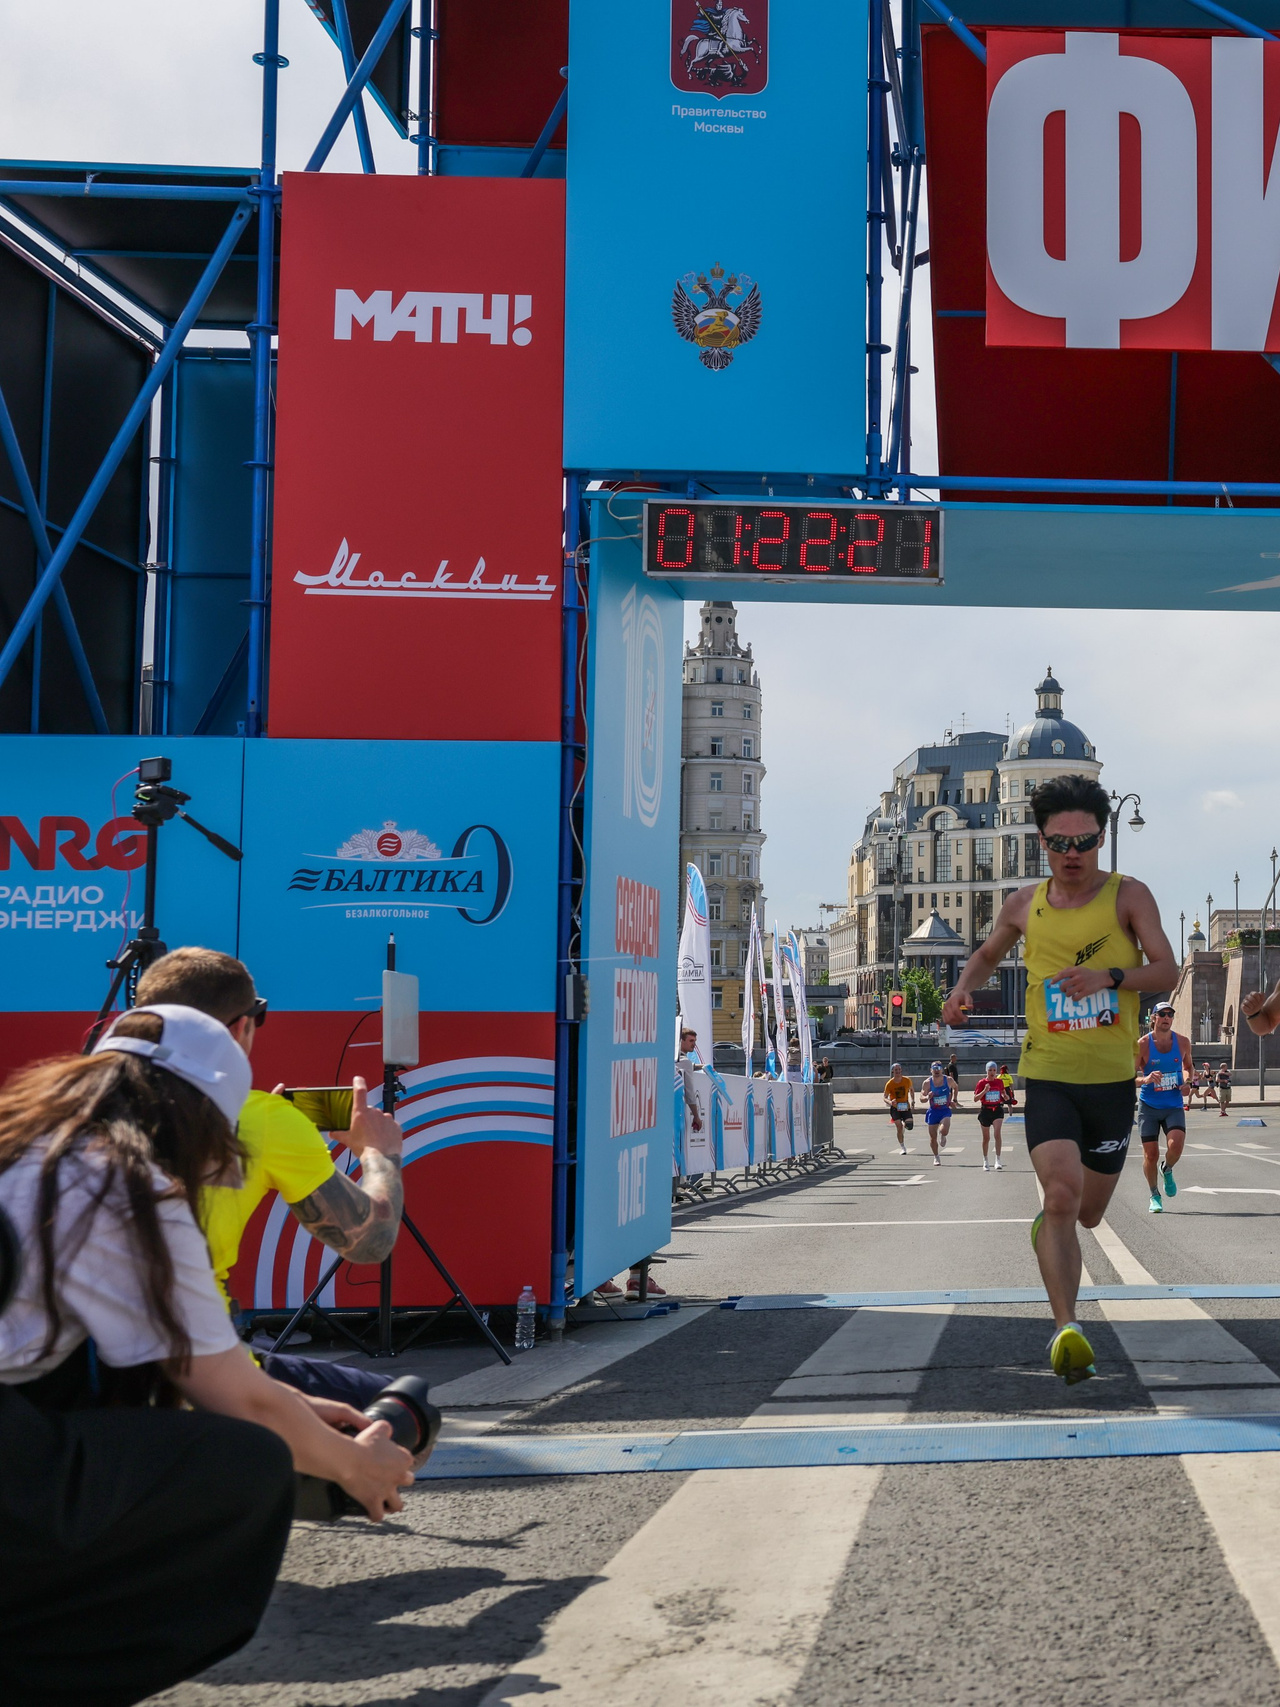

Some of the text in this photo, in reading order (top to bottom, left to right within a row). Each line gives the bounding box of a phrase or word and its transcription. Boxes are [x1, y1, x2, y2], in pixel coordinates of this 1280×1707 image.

[671, 104, 767, 120] Правительство
[694, 121, 744, 134] Москвы
[333, 288, 532, 347] МАТЧ!
[656, 508, 932, 573] 01:22:21
[320, 869, 485, 893] БАЛТИКА
[345, 909, 430, 919] БЕЗАЛКОГОЛЬНОЕ
[615, 875, 660, 965] СОЗДАЕМ
[613, 967, 659, 1045] БЕГОВУЮ
[1051, 988, 1111, 1019] 74310
[1068, 1016, 1098, 1031] 21.1KM
[1099, 1010, 1112, 1024] A
